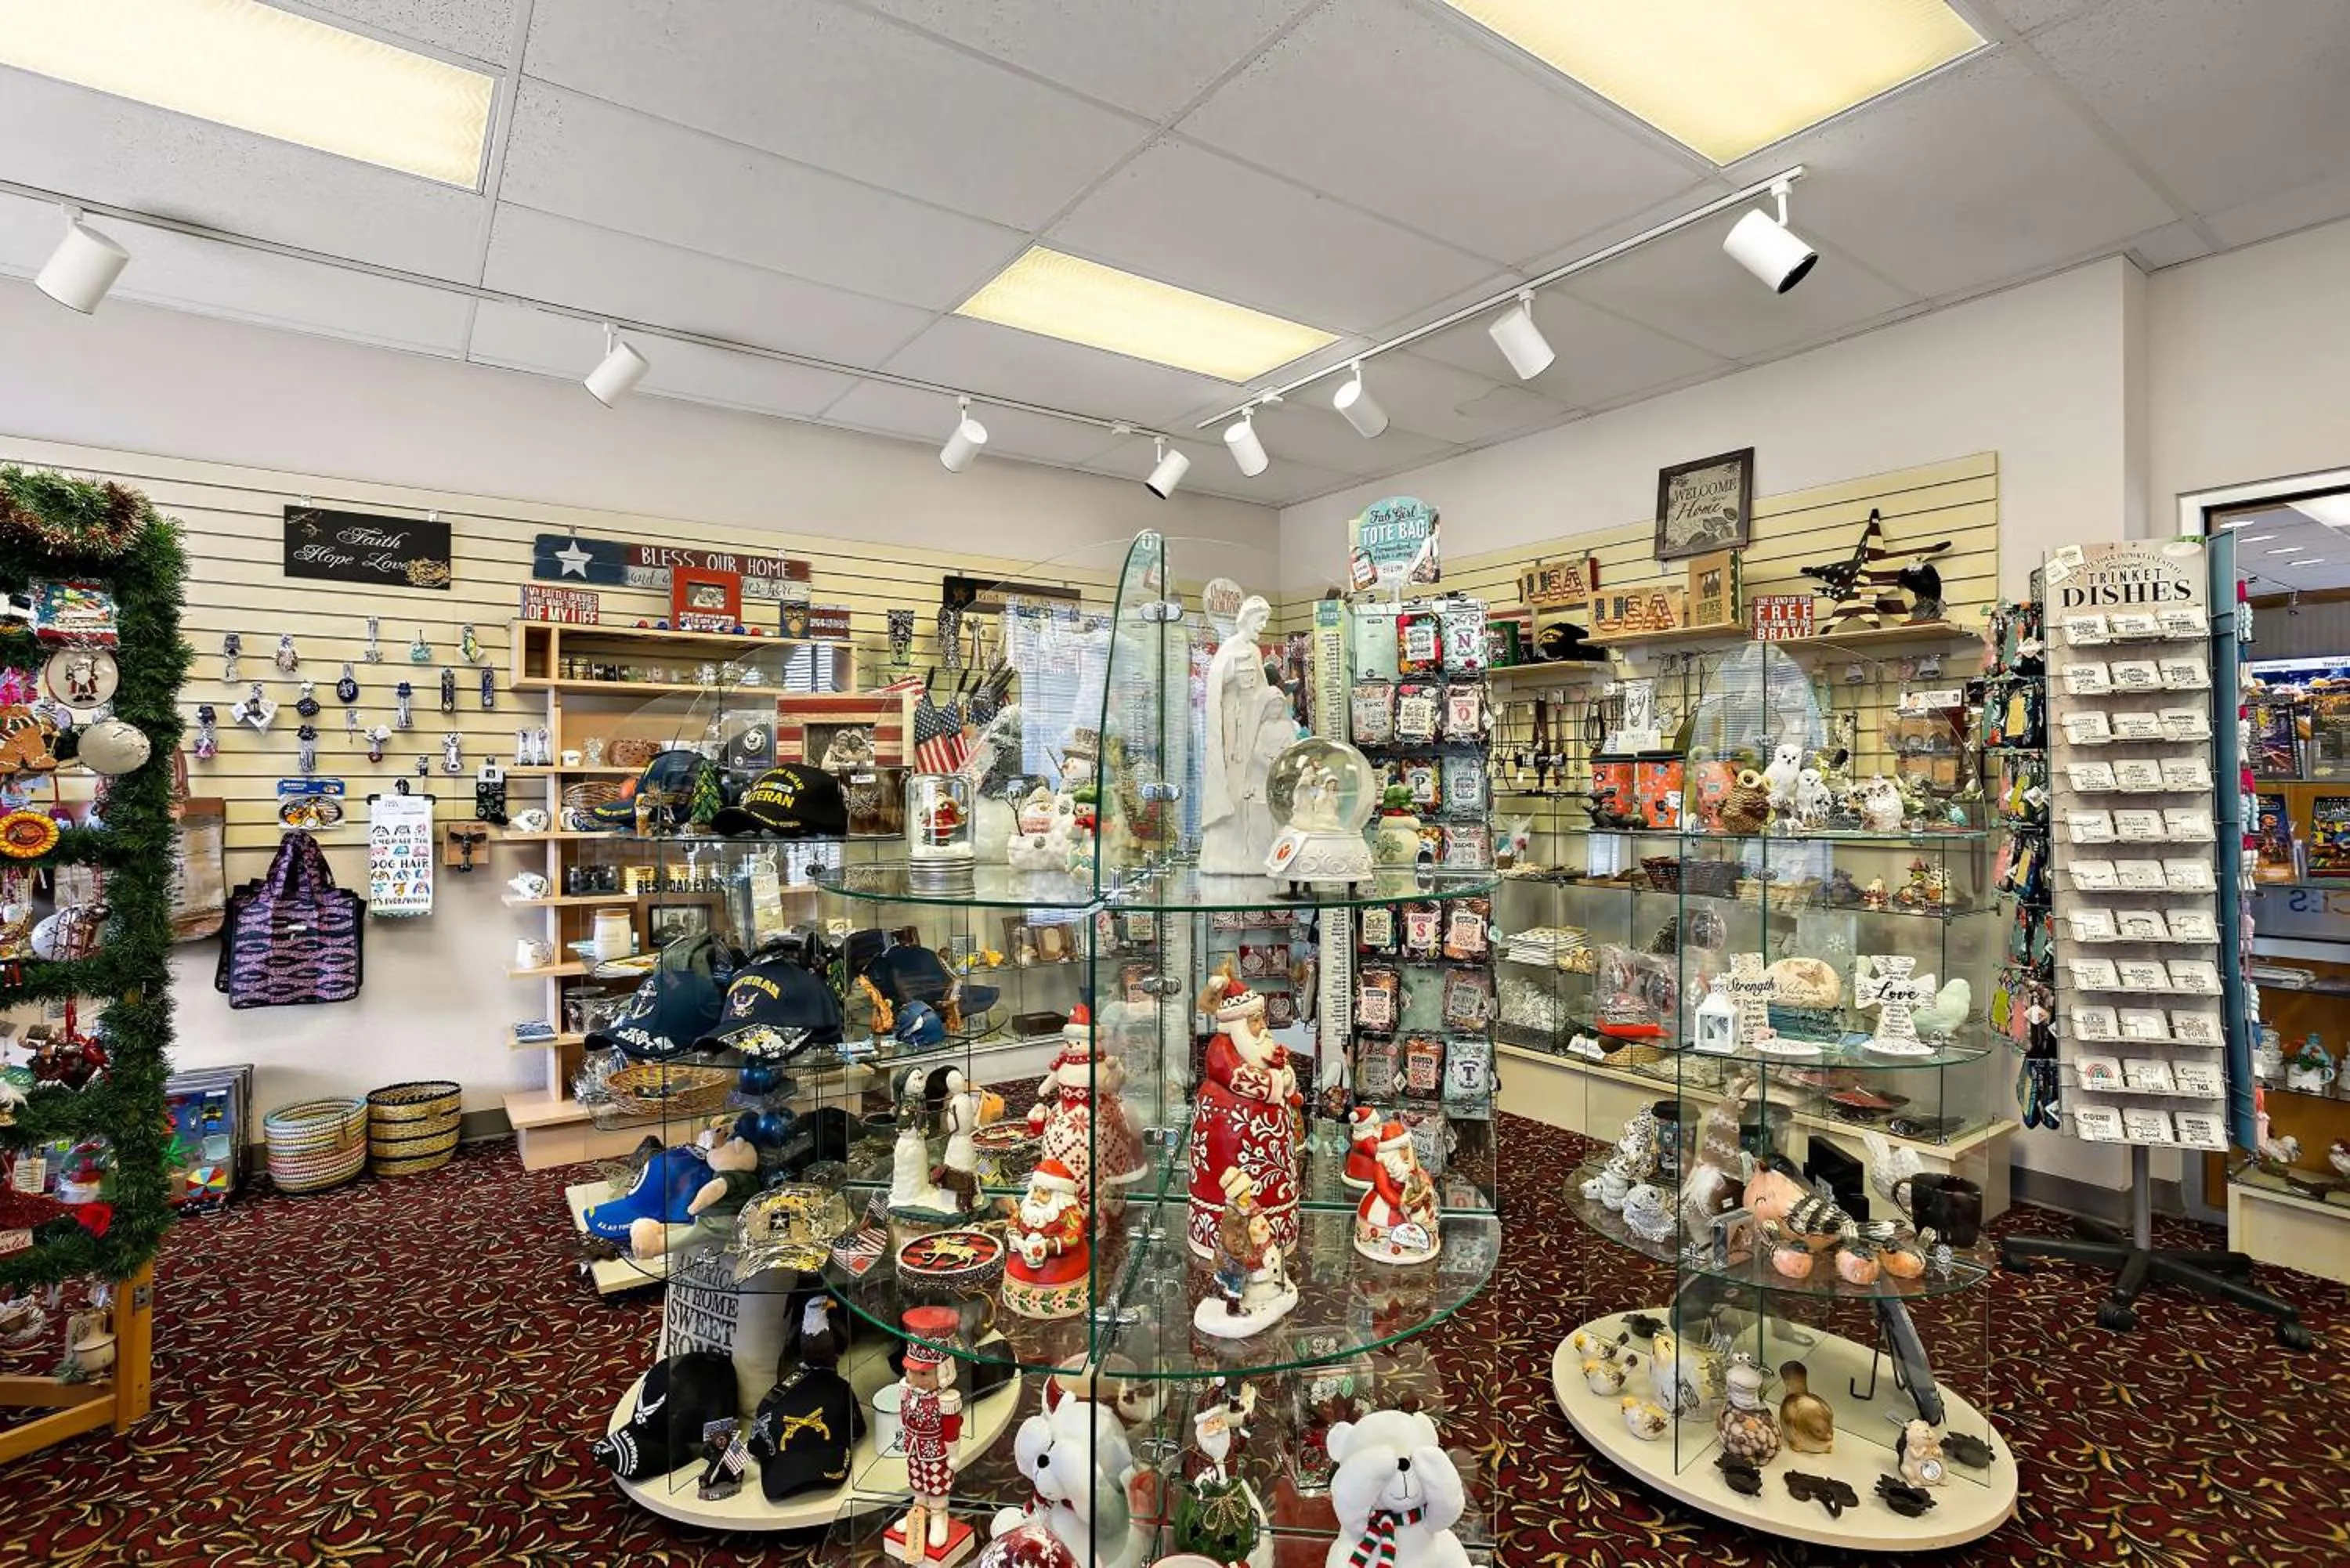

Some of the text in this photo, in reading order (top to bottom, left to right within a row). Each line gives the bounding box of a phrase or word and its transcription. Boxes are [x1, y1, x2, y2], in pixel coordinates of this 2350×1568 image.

[1674, 478, 1737, 502] WELCOME
[1369, 505, 1416, 524] Fab Girl
[1676, 498, 1723, 521] Home
[336, 526, 411, 549] Faith
[1361, 518, 1426, 547] TOTE BAG
[293, 544, 408, 573] Hope Love
[641, 547, 790, 580] BLESS OUR HOME
[630, 570, 656, 586] and
[1528, 567, 1586, 603] USA
[2088, 568, 2162, 585] TRINKET
[1757, 598, 1770, 606] THE
[2062, 579, 2191, 609] DISHES
[528, 604, 598, 624] OF MY LIFE
[1595, 594, 1676, 631] USA
[1757, 604, 1812, 620] FREE
[1458, 634, 1470, 649] N
[1757, 627, 1812, 640] BRAVE
[1414, 776, 1426, 792] P
[371, 858, 429, 869] DOG HAIR
[1415, 922, 1426, 938] S
[1726, 977, 1775, 996] Strength
[1875, 980, 1920, 1001] Love
[1462, 1066, 1476, 1082] T
[677, 1253, 740, 1292] AMERICA
[692, 1287, 739, 1317] HOME
[669, 1298, 737, 1348] SWEET
